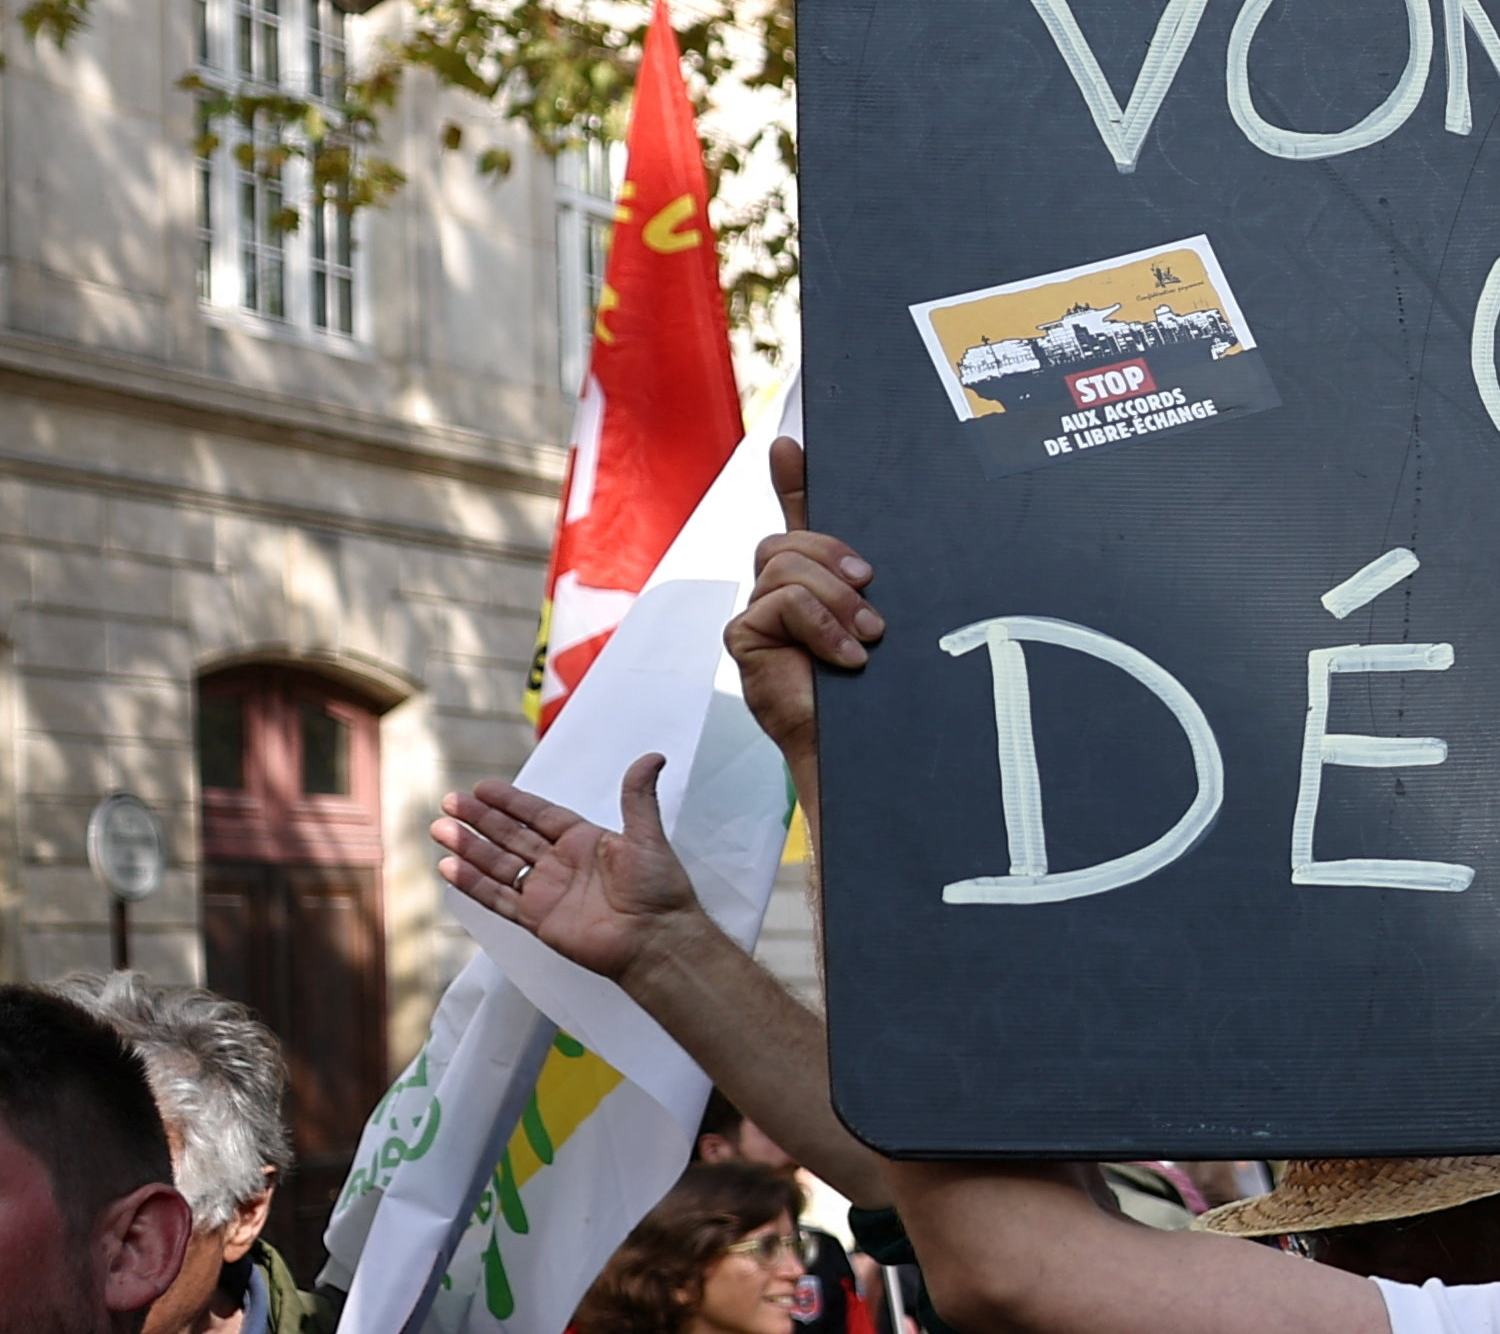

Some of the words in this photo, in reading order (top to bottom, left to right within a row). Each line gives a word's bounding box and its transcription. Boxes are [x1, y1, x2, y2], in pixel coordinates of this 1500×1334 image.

[1075, 365, 1145, 404] STOP
[1043, 435, 1073, 458] DE
[1072, 399, 1219, 451] LIBRE-ÉCHANGE
[1061, 408, 1103, 434] AUX
[1104, 386, 1187, 419] ACCORDS
